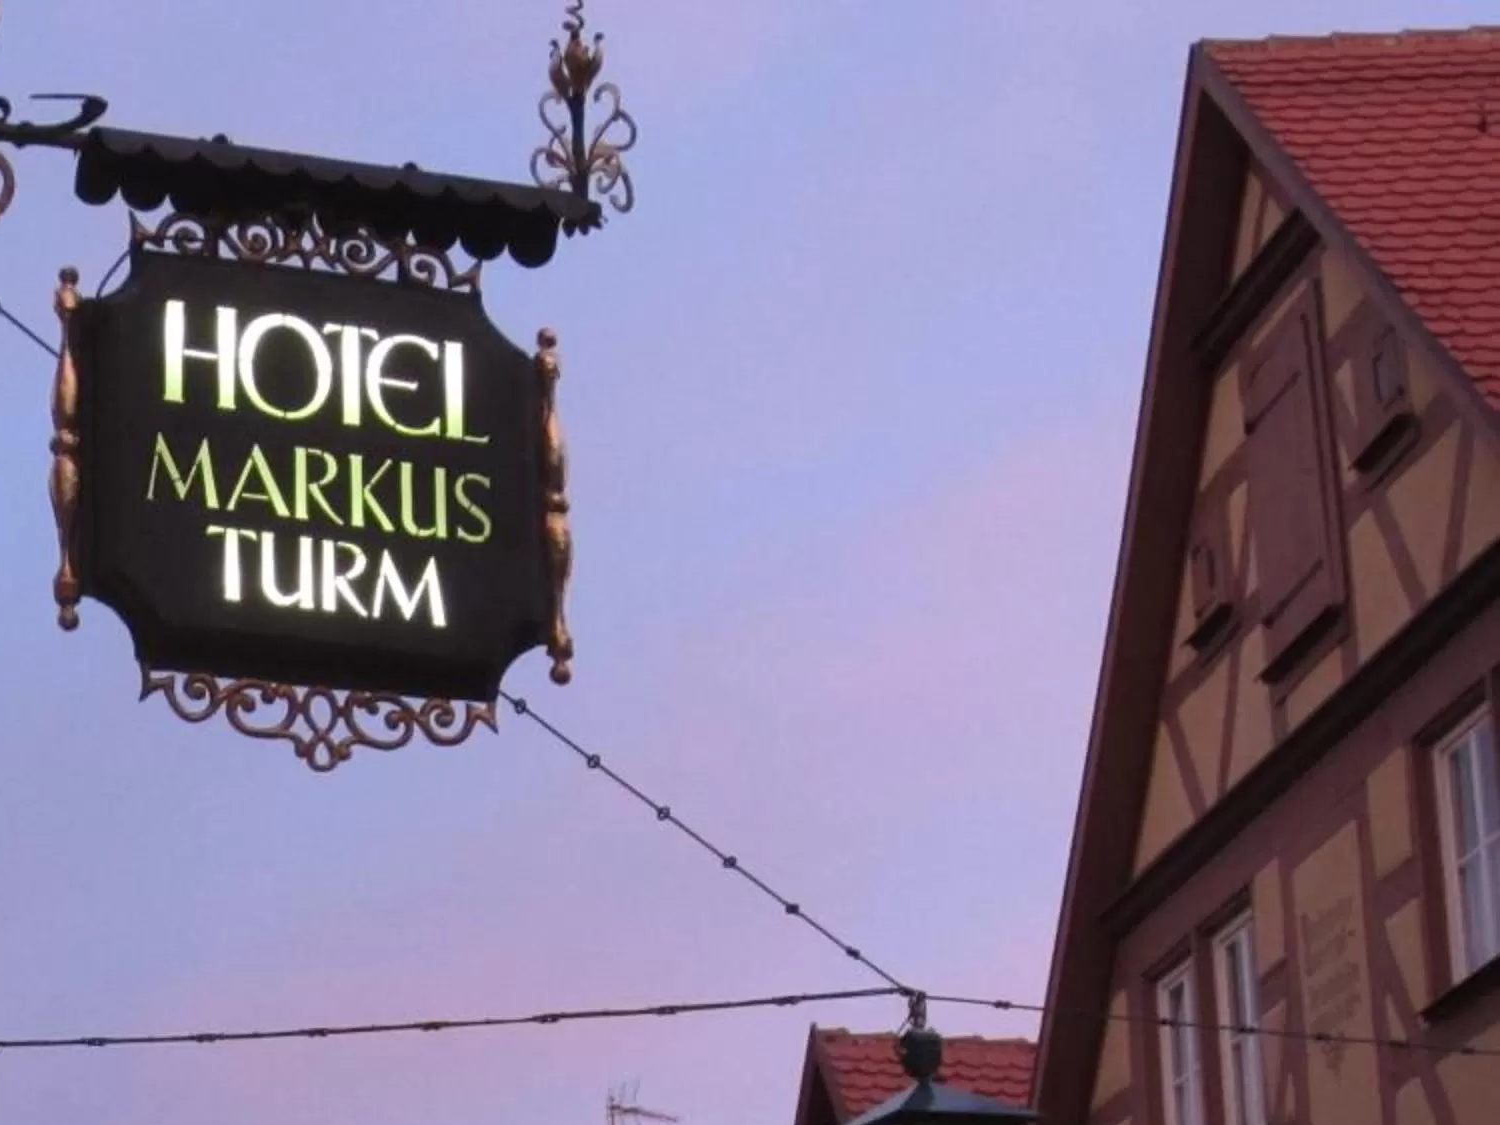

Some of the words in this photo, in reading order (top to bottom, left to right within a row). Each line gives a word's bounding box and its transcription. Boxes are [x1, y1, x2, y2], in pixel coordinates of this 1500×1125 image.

[163, 299, 489, 443] HOTEL
[147, 432, 491, 543] MARKUS
[206, 525, 447, 628] TURM
